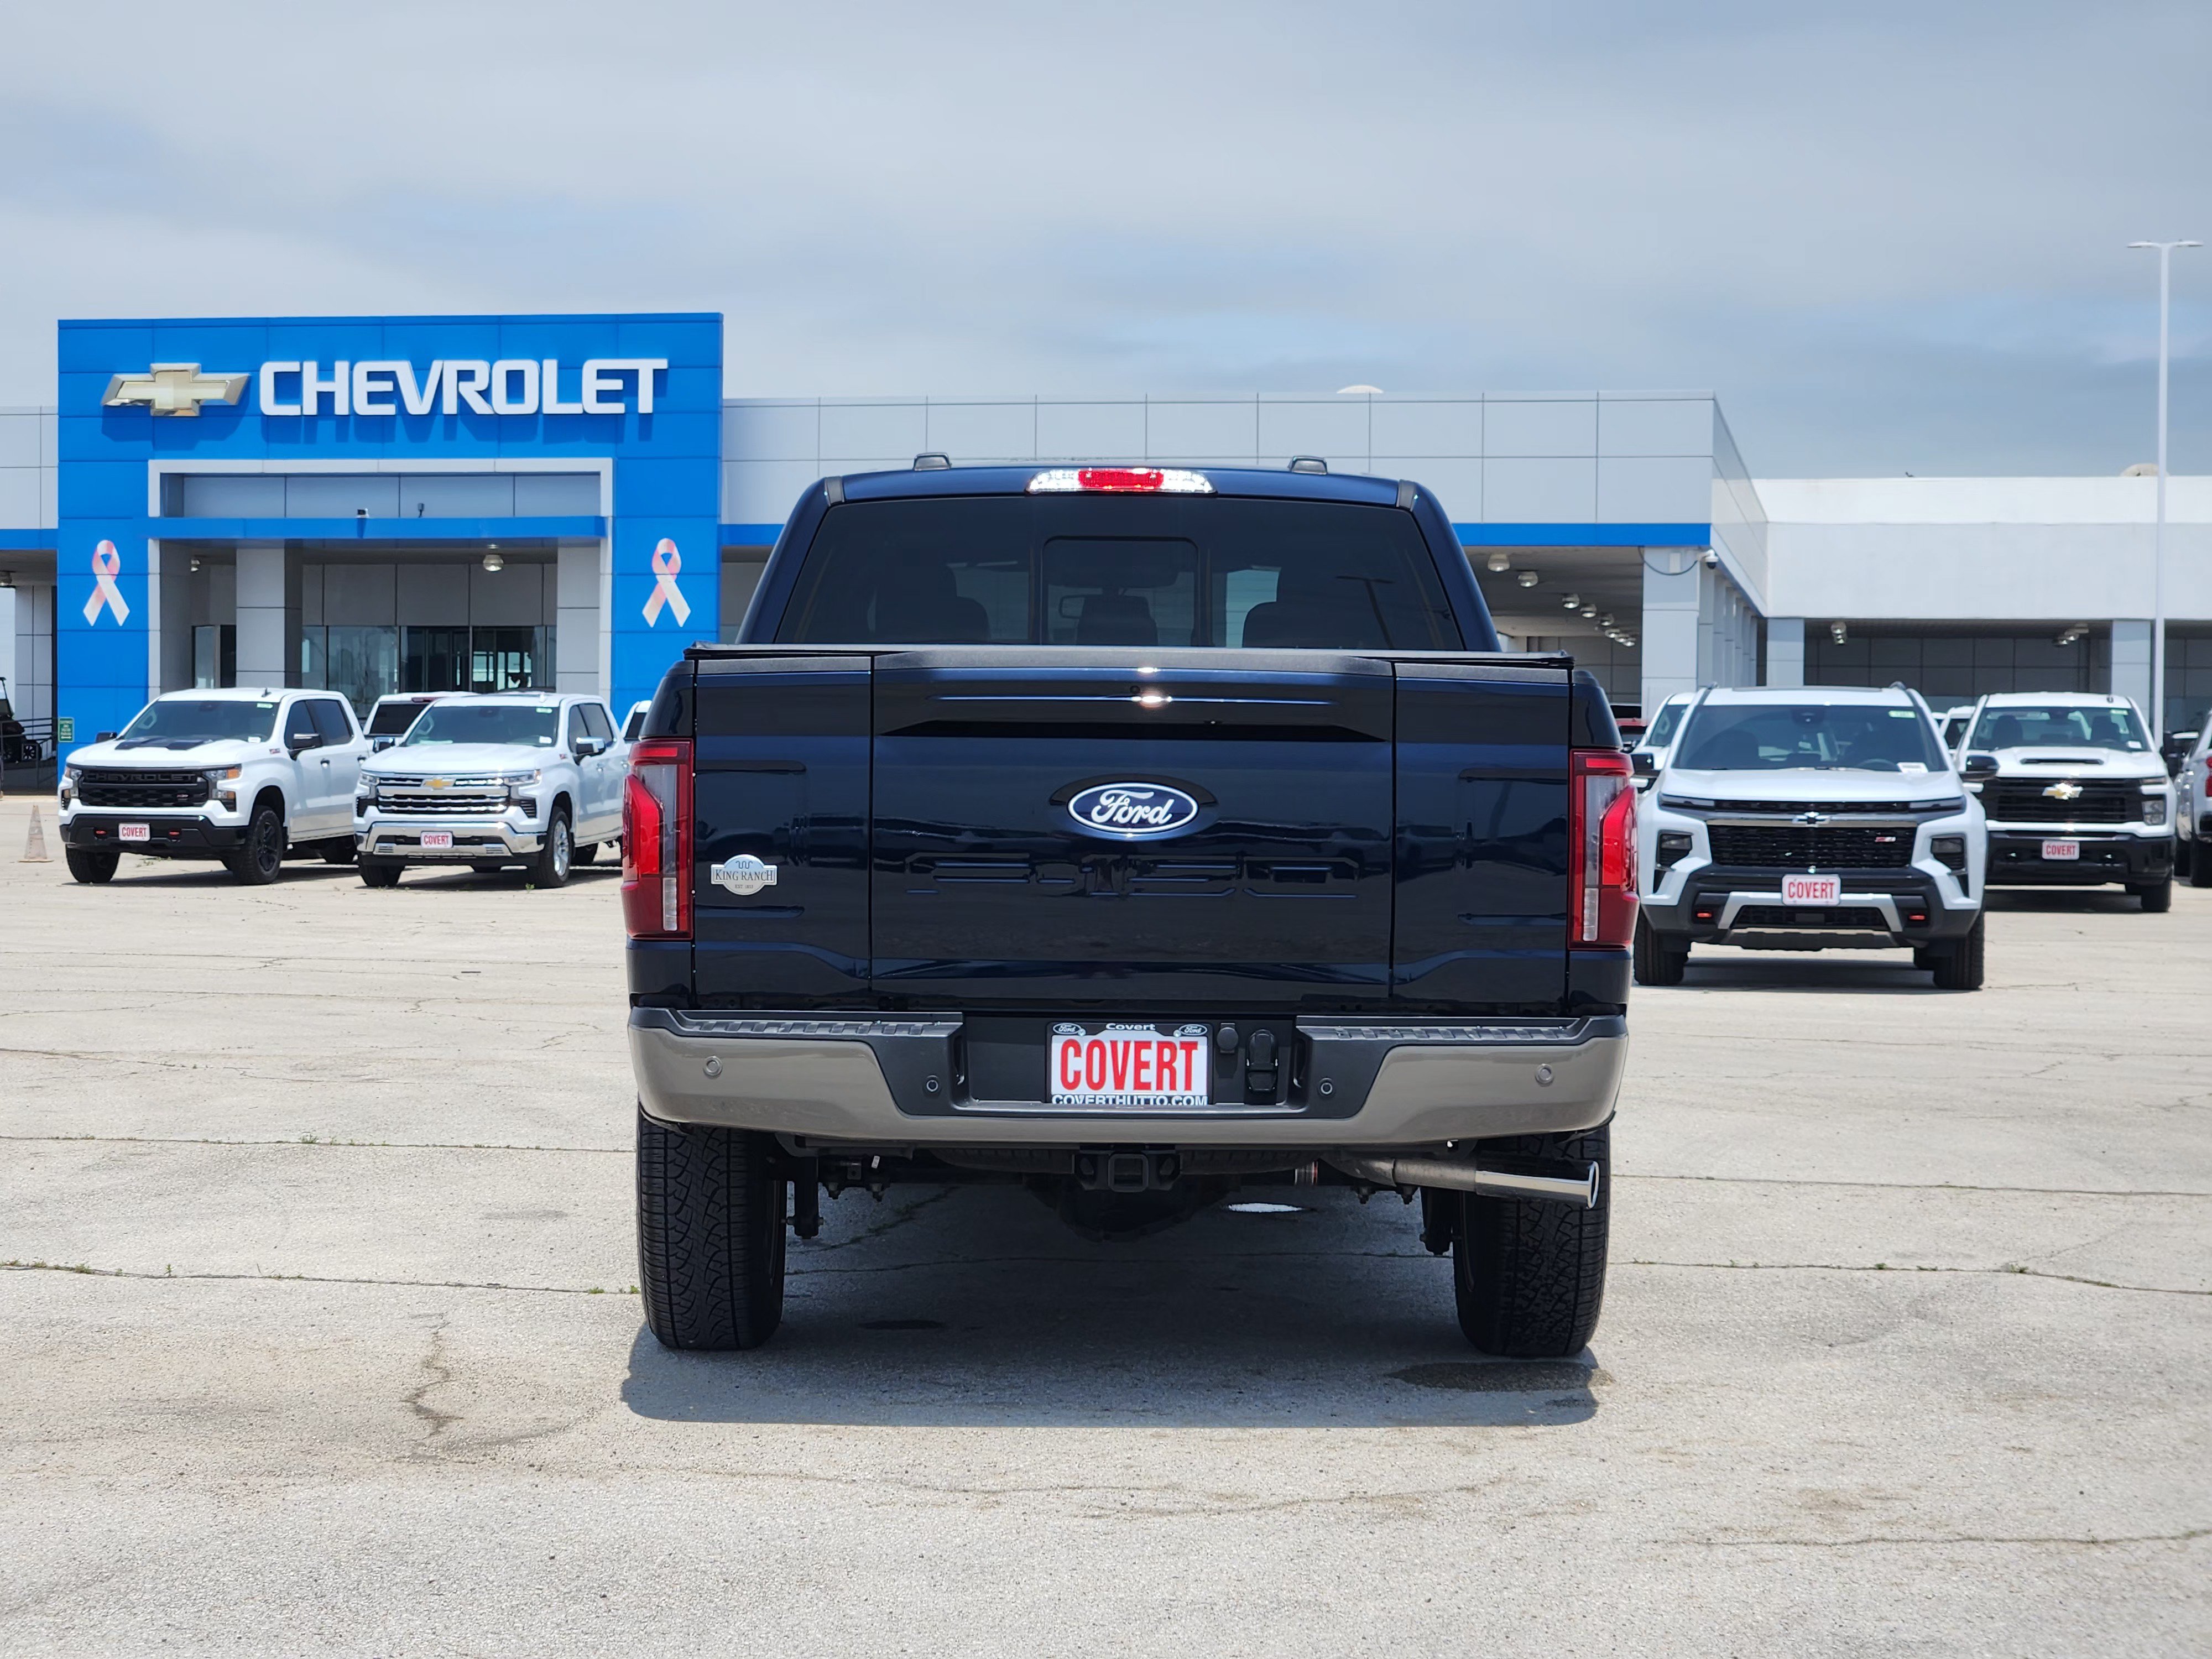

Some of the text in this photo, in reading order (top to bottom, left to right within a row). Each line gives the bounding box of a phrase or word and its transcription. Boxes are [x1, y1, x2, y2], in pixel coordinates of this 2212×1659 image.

[259, 359, 667, 416] CHEVROLET
[1091, 790, 1175, 824] Ford
[122, 827, 147, 837] COVERT
[424, 834, 449, 845] COVERT
[2046, 845, 2075, 855] COVERT
[715, 869, 773, 881] KING RANCH
[1788, 881, 1834, 899] COVERT
[1060, 1039, 1198, 1091] COVERT
[1052, 1094, 1208, 1106] COVERTHUTTO.COM
